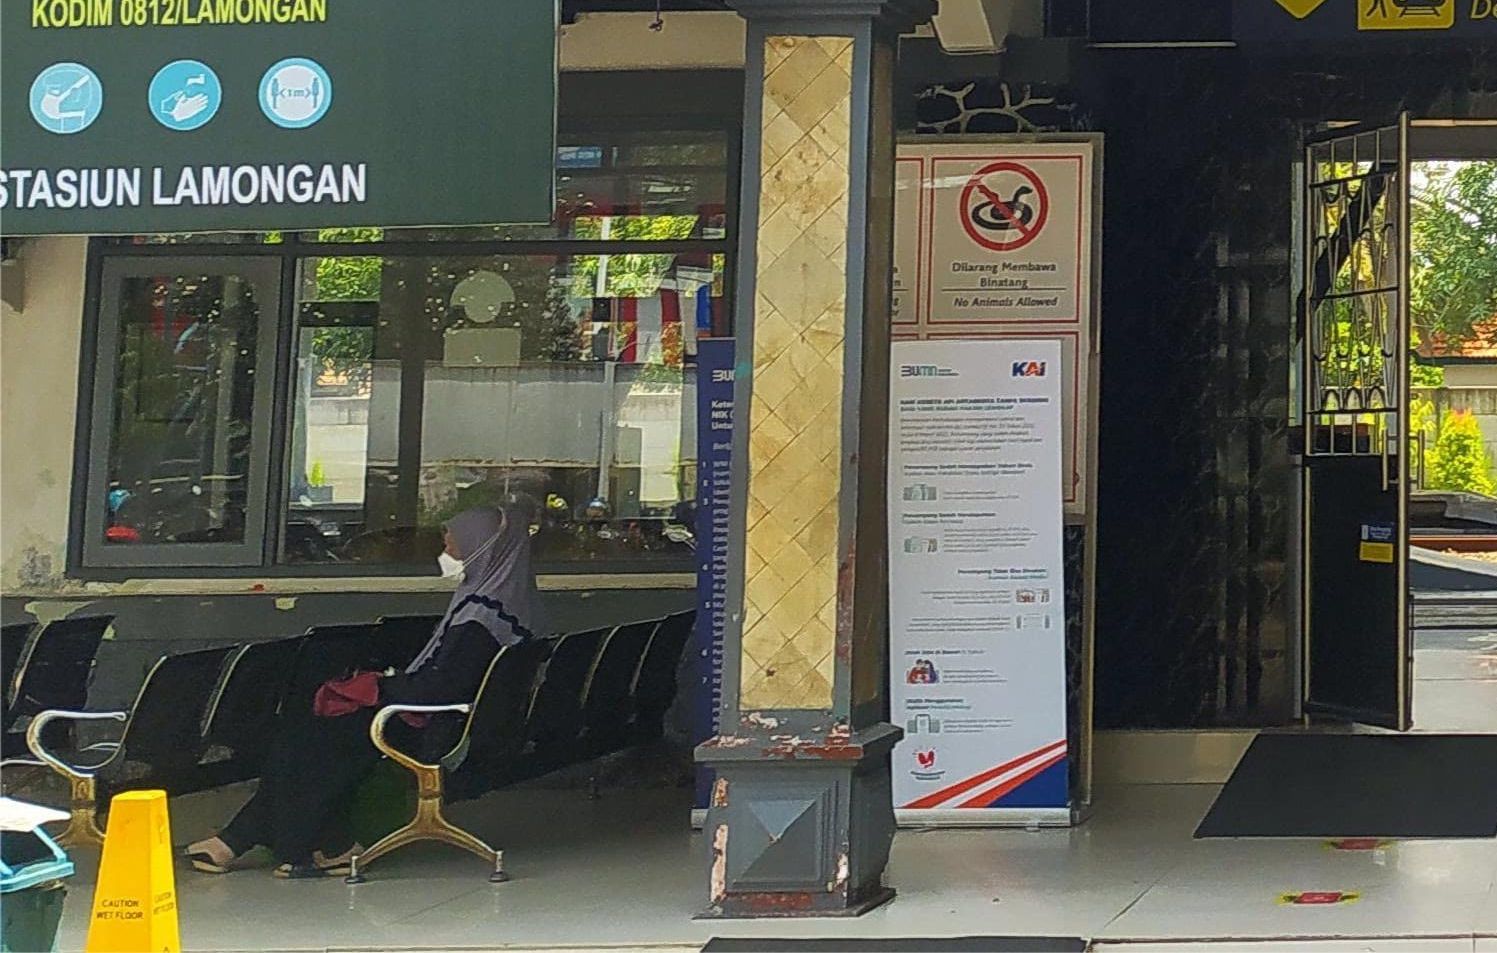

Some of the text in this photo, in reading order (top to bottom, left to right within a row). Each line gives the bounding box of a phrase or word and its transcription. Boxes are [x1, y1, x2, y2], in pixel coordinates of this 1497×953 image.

[153, 164, 366, 206] LAMONGAN
[952, 261, 1056, 274] Dilarang Membawa
[980, 278, 1028, 289] Binatang
[954, 296, 1058, 308] No Animals Allowed
[102, 899, 140, 907] CAUTION
[96, 911, 144, 920] WET FLOOR
